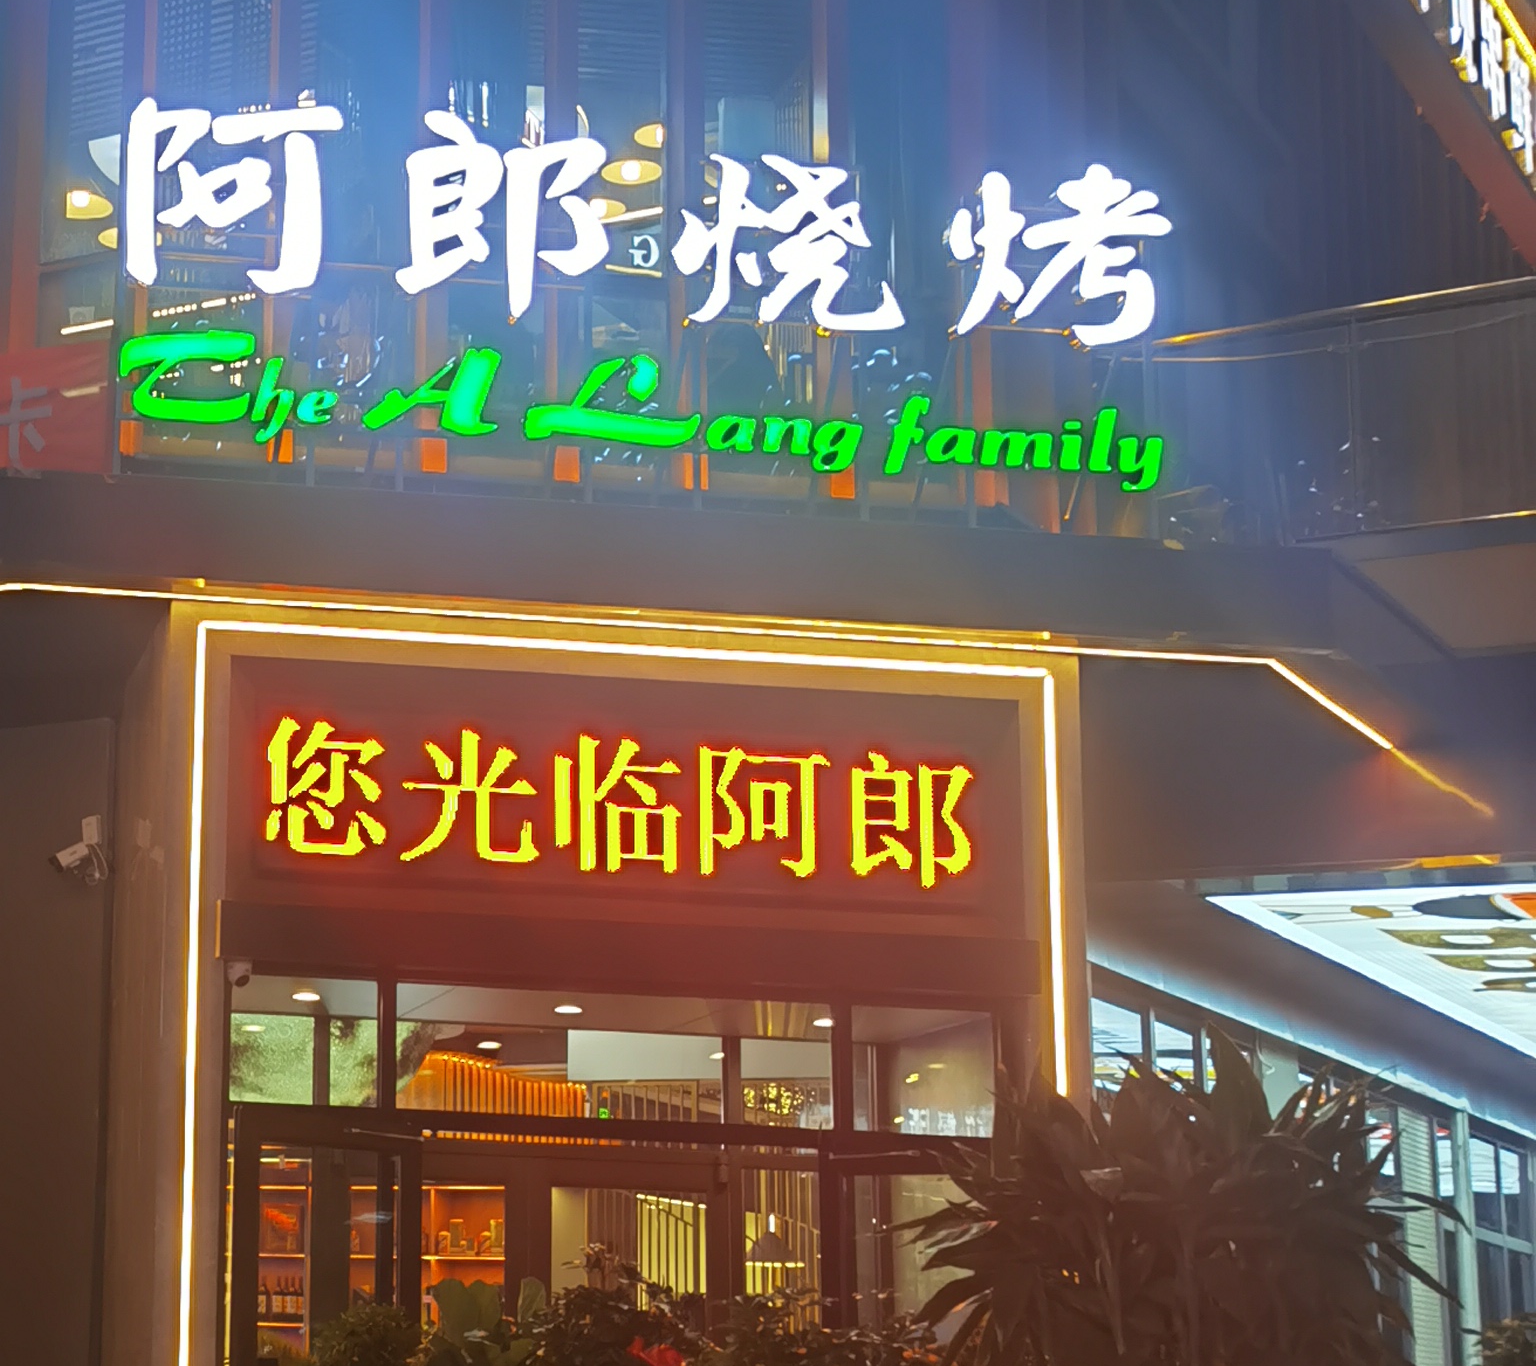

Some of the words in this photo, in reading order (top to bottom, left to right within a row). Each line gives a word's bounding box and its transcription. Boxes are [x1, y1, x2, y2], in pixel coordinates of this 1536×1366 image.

[121, 97, 1173, 347] 阿郎烧烤
[119, 327, 340, 443] The
[360, 347, 503, 436] A
[523, 353, 864, 473] Lang
[883, 395, 1164, 492] family
[265, 716, 972, 889] 您光临阿郎
